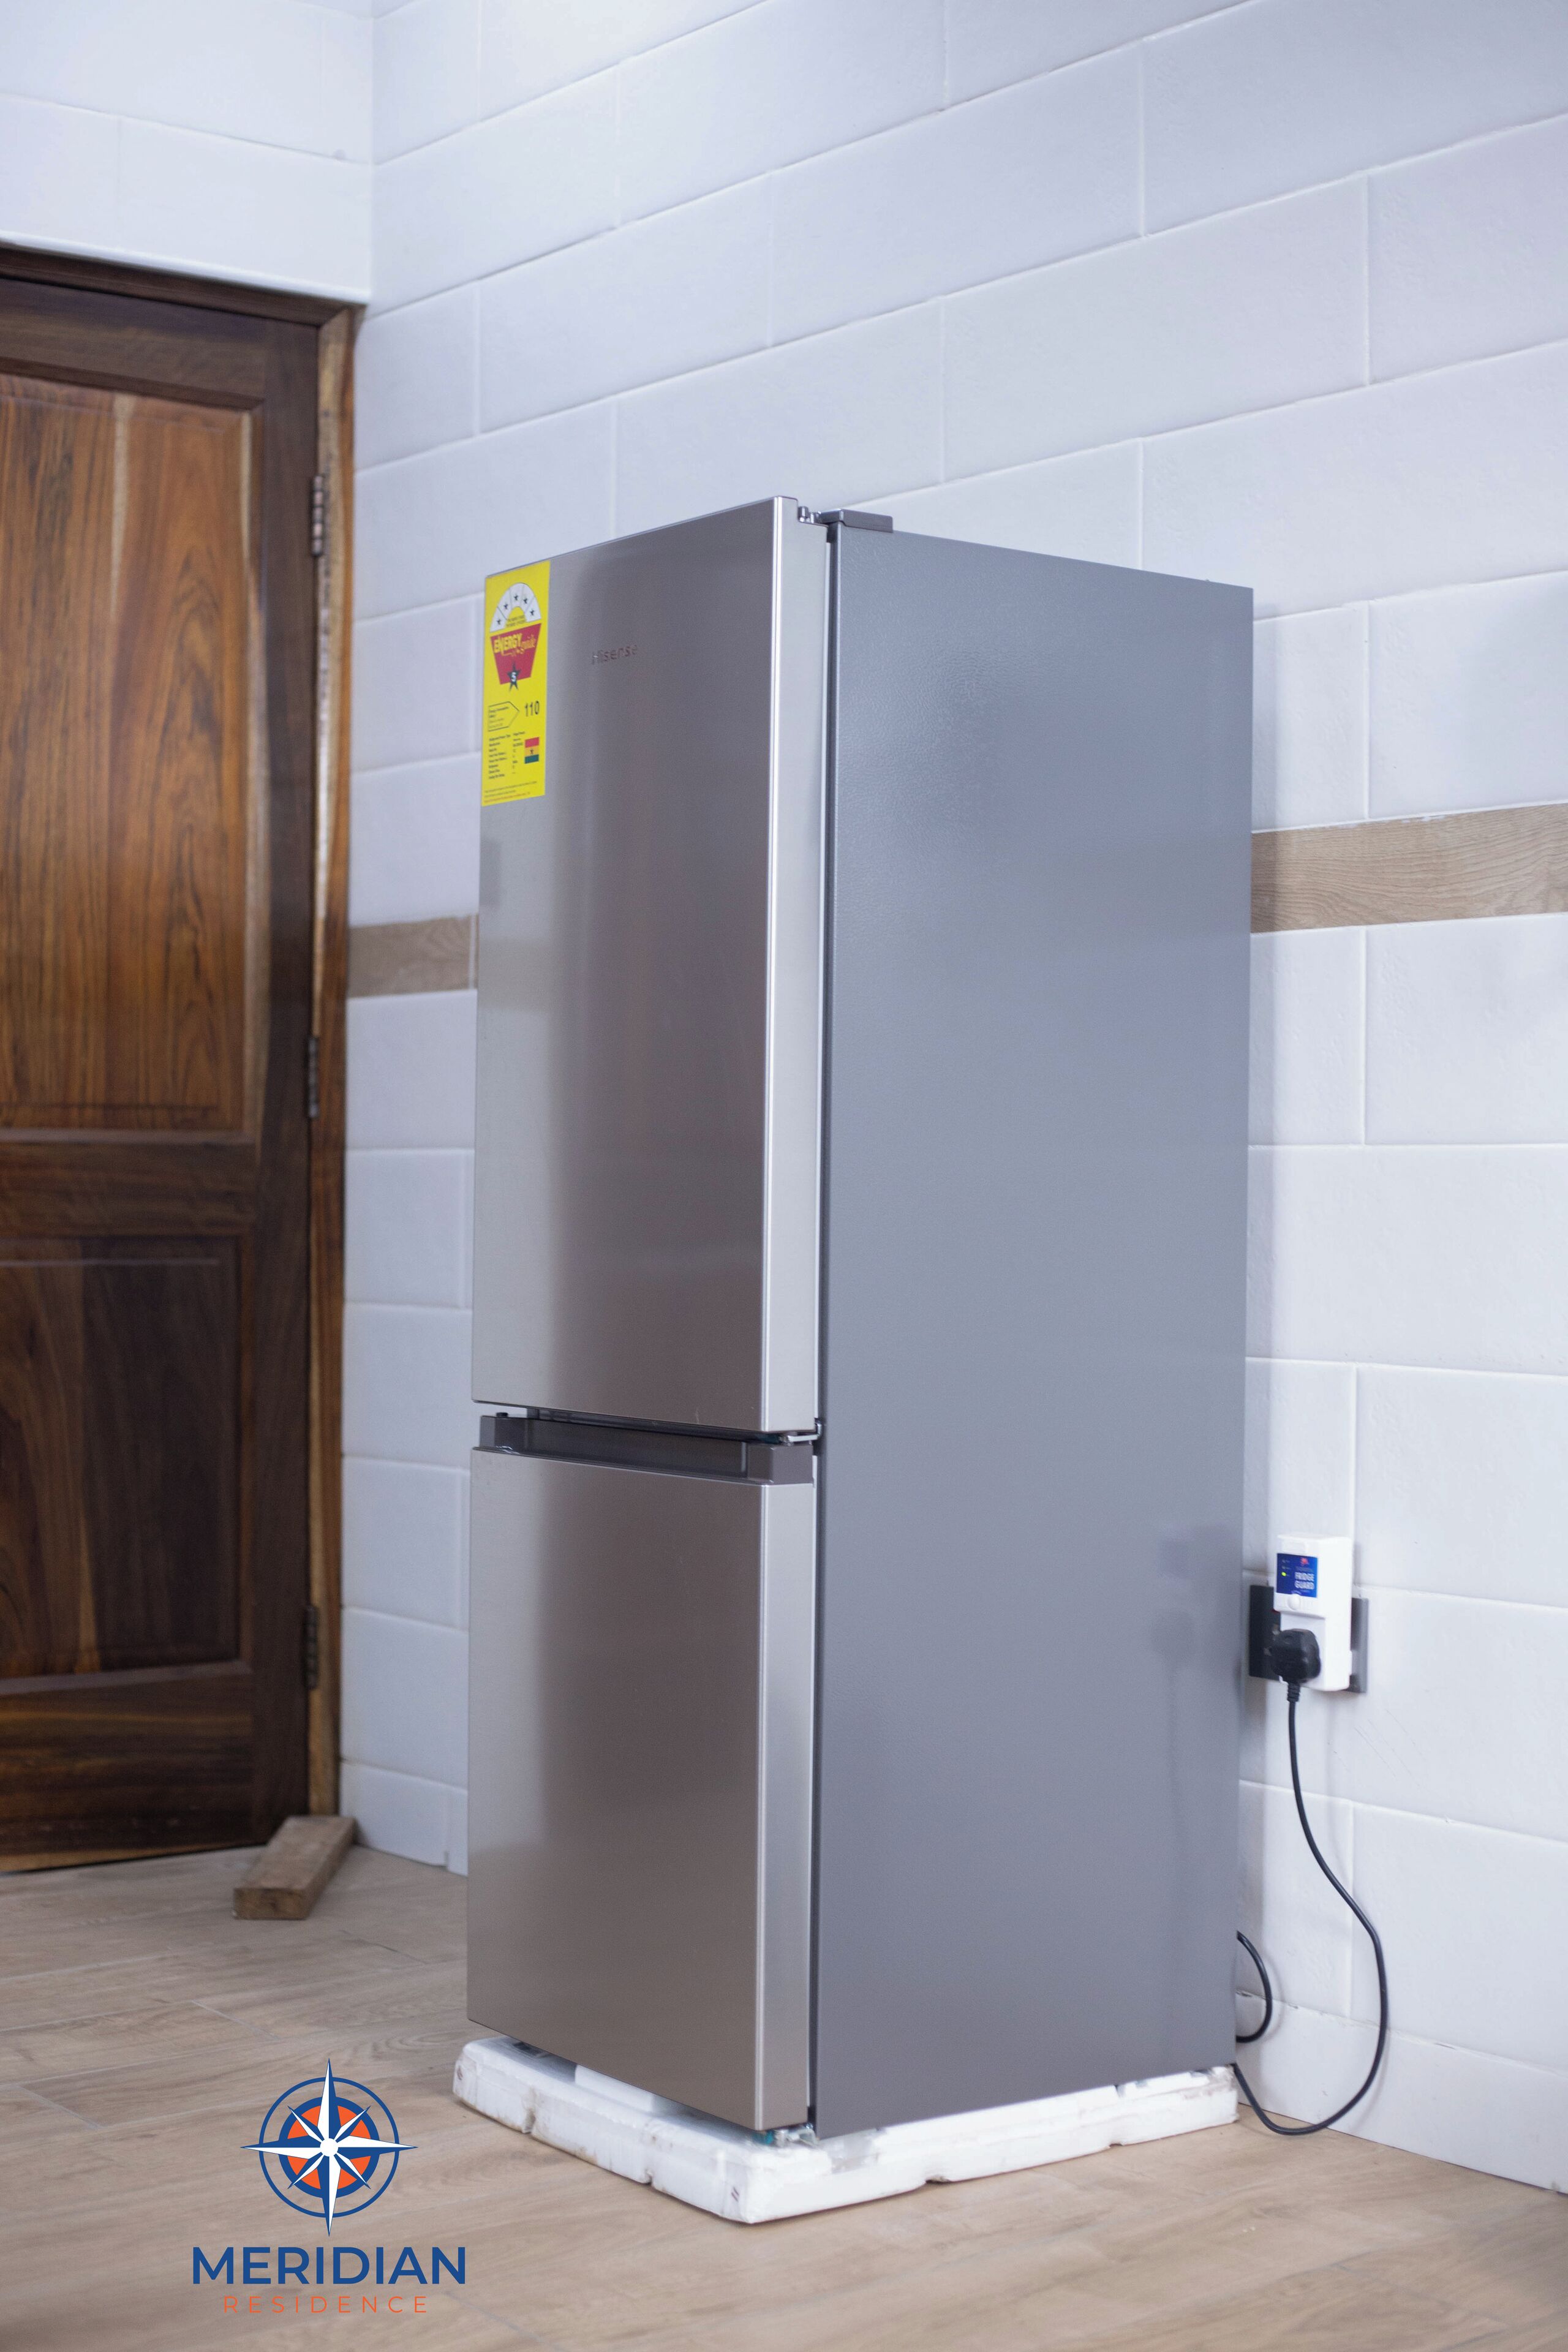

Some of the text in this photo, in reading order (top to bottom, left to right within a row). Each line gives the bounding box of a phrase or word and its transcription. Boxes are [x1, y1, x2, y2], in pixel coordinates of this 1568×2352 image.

[524, 700, 540, 717] 110
[1295, 1572, 1314, 1581] FRIDGE
[1294, 1581, 1314, 1589] GUARD
